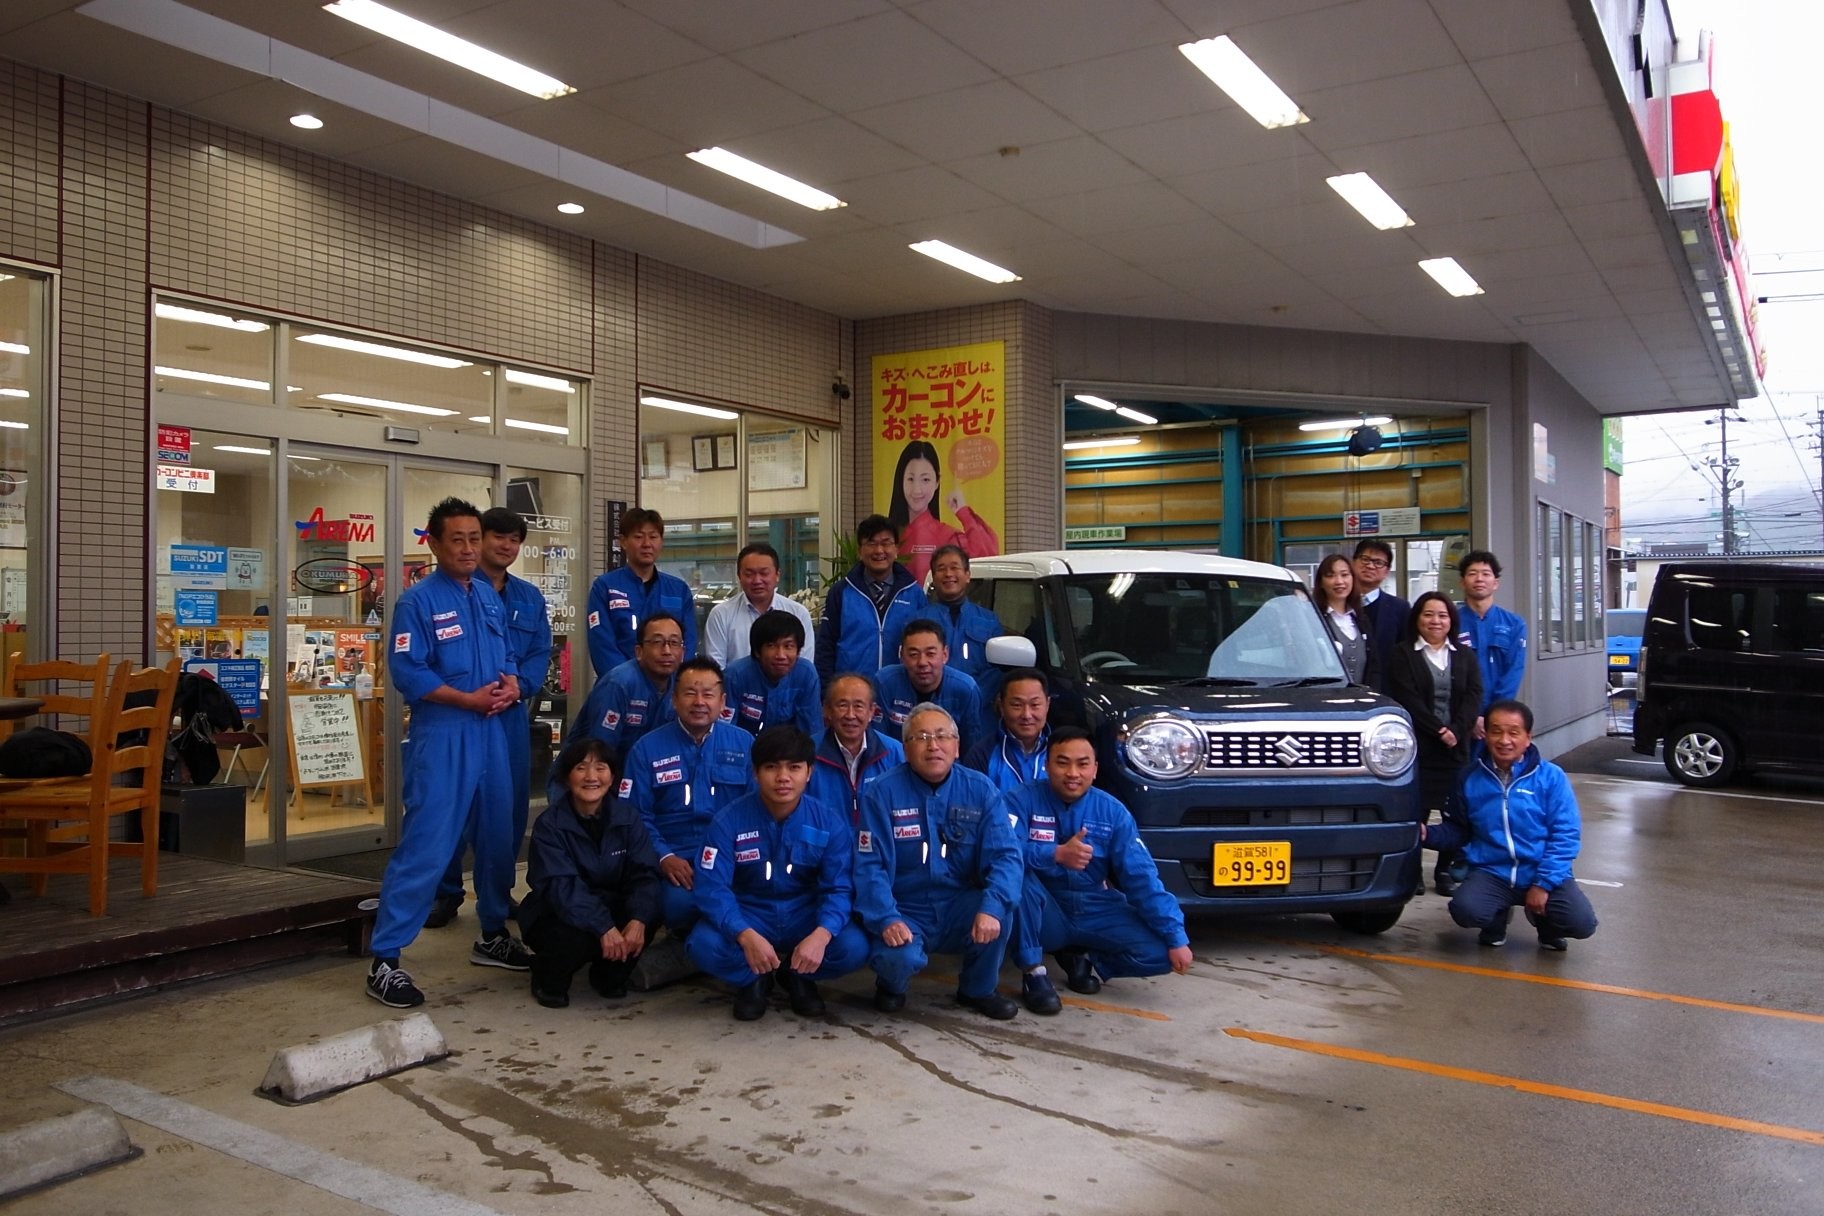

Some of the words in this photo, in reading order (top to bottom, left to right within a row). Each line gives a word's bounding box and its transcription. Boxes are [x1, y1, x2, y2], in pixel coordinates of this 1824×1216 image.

[882, 379, 995, 414] カーコンに
[881, 408, 995, 441] おまかせ!
[158, 451, 189, 461] SECOM
[296, 507, 374, 543] ARENA
[173, 555, 199, 563] SUZUKI
[199, 550, 225, 563] SDT
[653, 755, 680, 767] SUZUKI
[892, 807, 919, 816] SUZUKI
[736, 830, 759, 841] ZUKI
[1232, 847, 1254, 858] 滋賀
[1255, 846, 1273, 858] 581
[1218, 866, 1229, 877] の
[1231, 860, 1286, 882] 99-99
